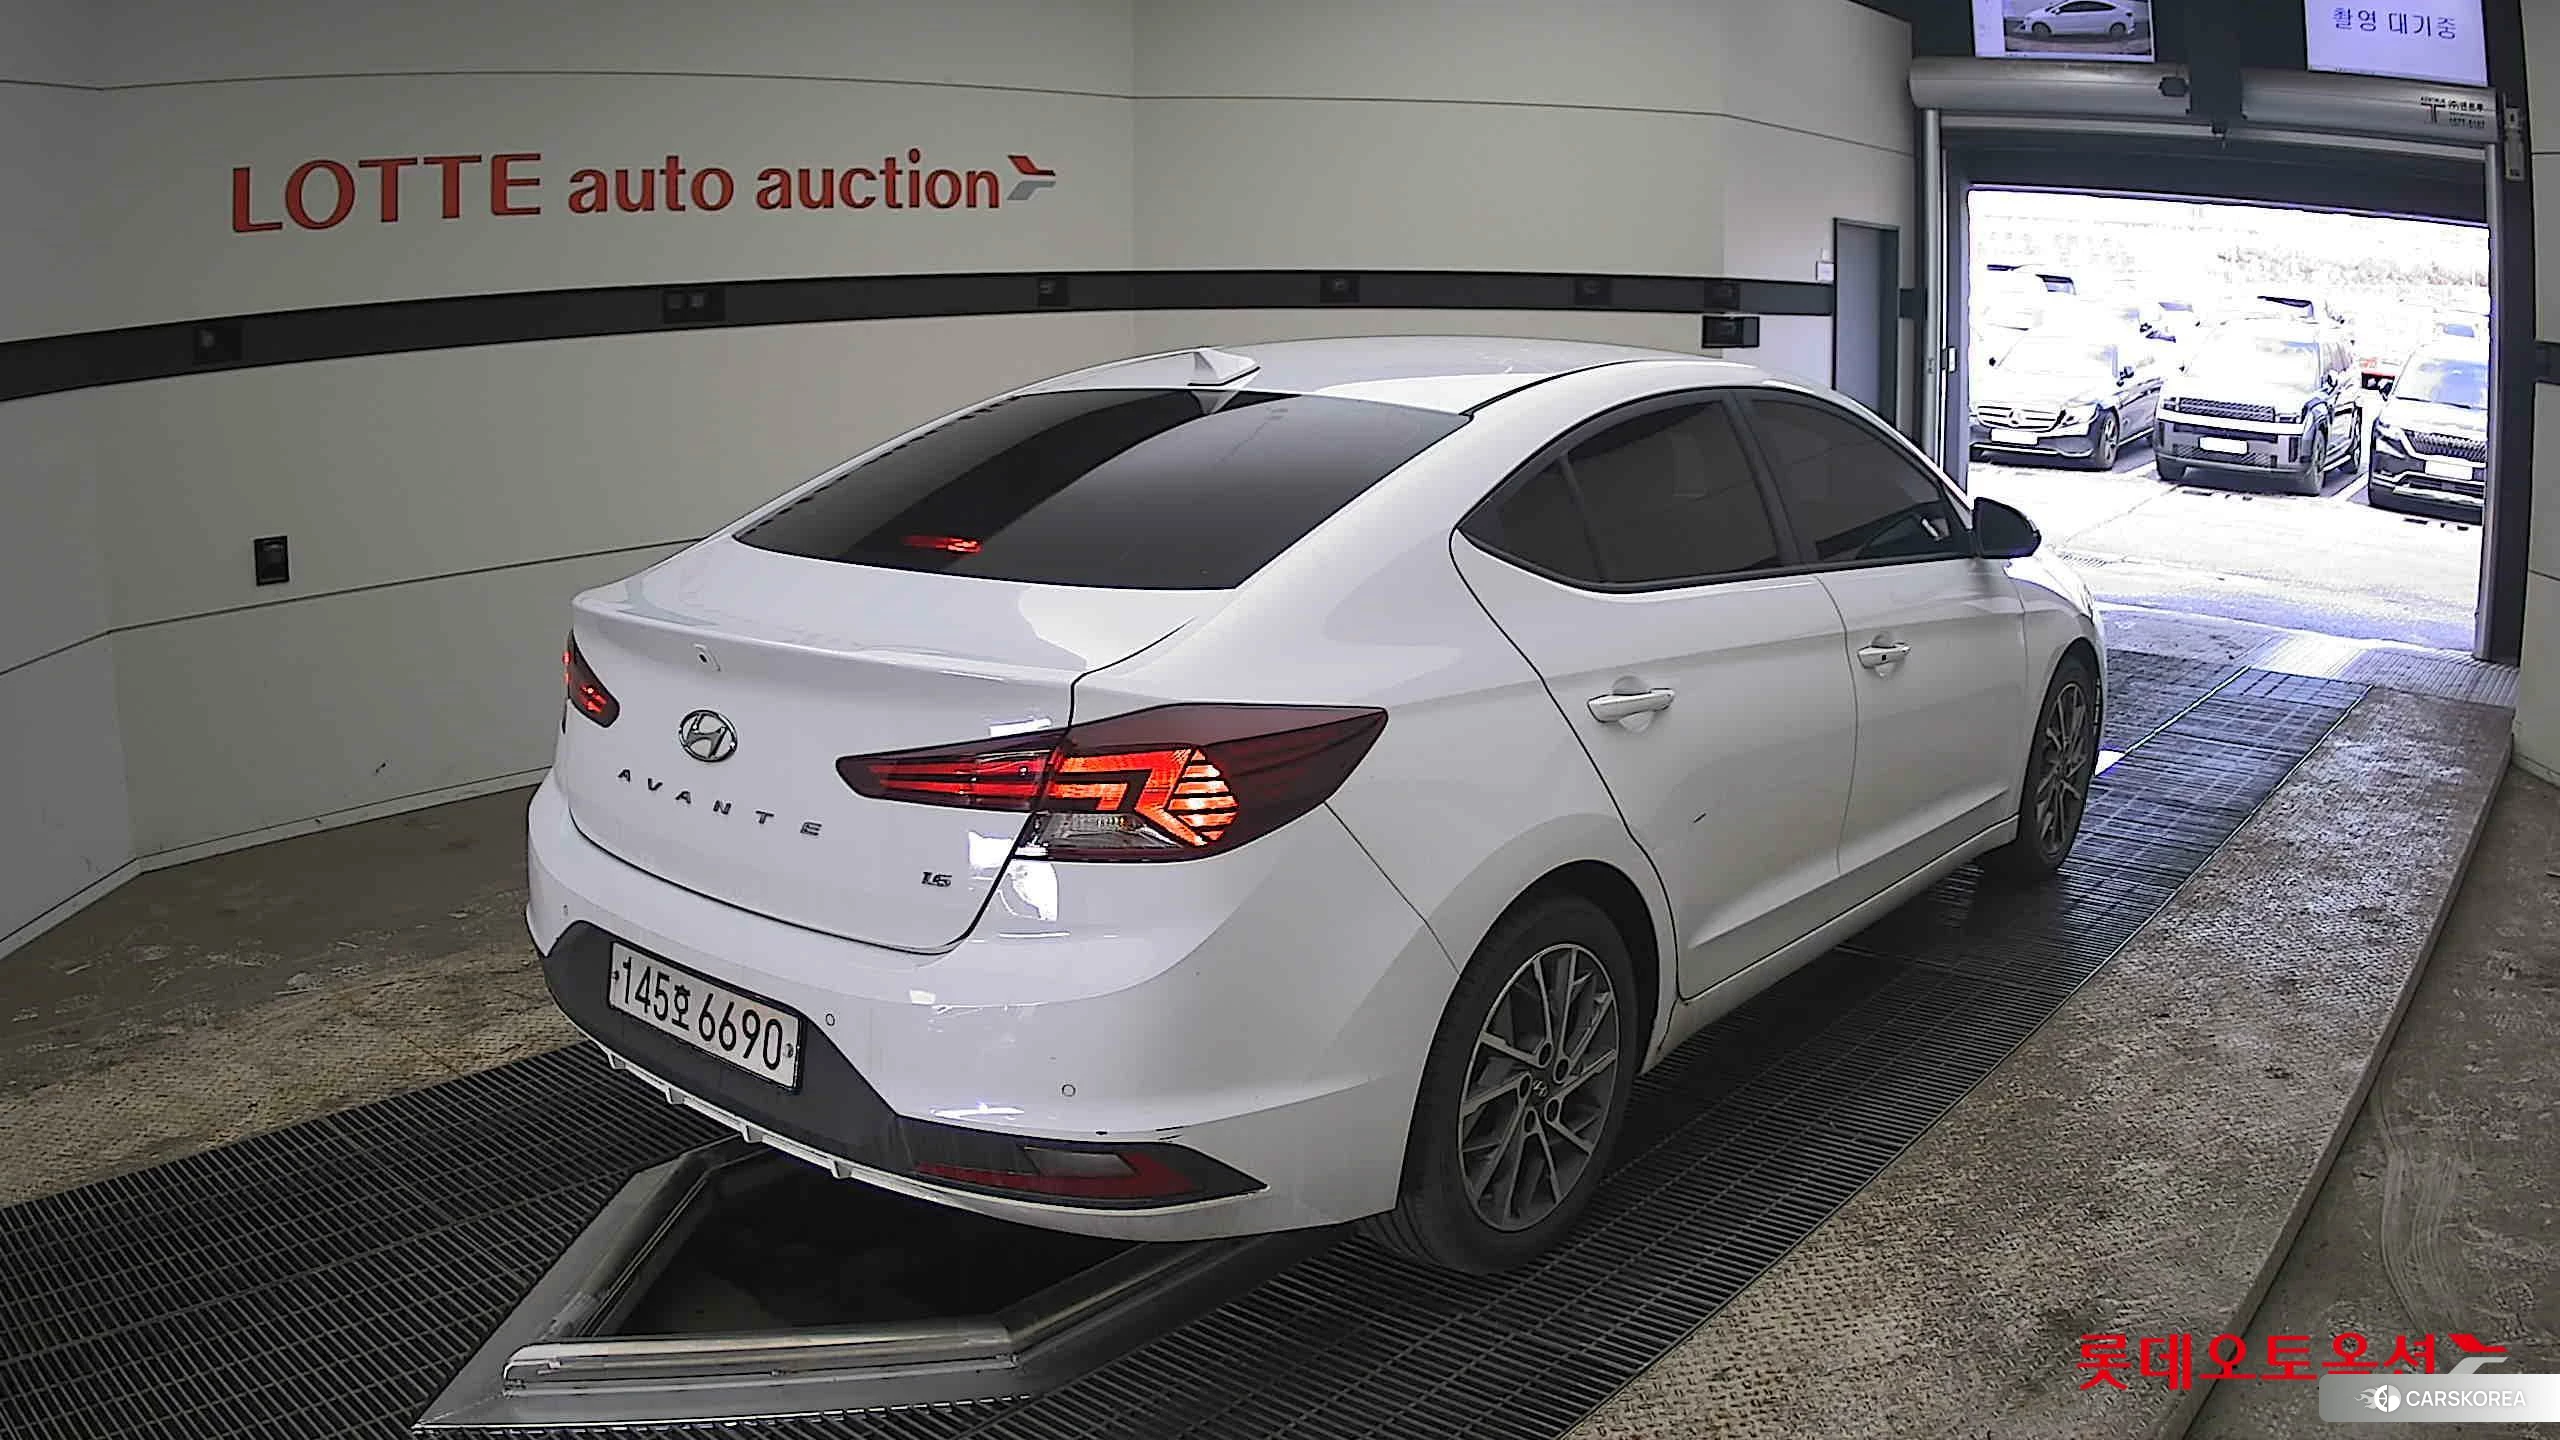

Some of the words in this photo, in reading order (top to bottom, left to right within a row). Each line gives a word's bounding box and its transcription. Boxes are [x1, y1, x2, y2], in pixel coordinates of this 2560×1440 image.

[2333, 8, 2377, 32] 촬영
[2388, 13, 2456, 40] 대기중
[232, 152, 542, 233] LOTTE
[568, 155, 735, 213] auto
[756, 147, 1001, 210] auction
[617, 768, 823, 836] AVANTE
[698, 993, 783, 1071] 6690
